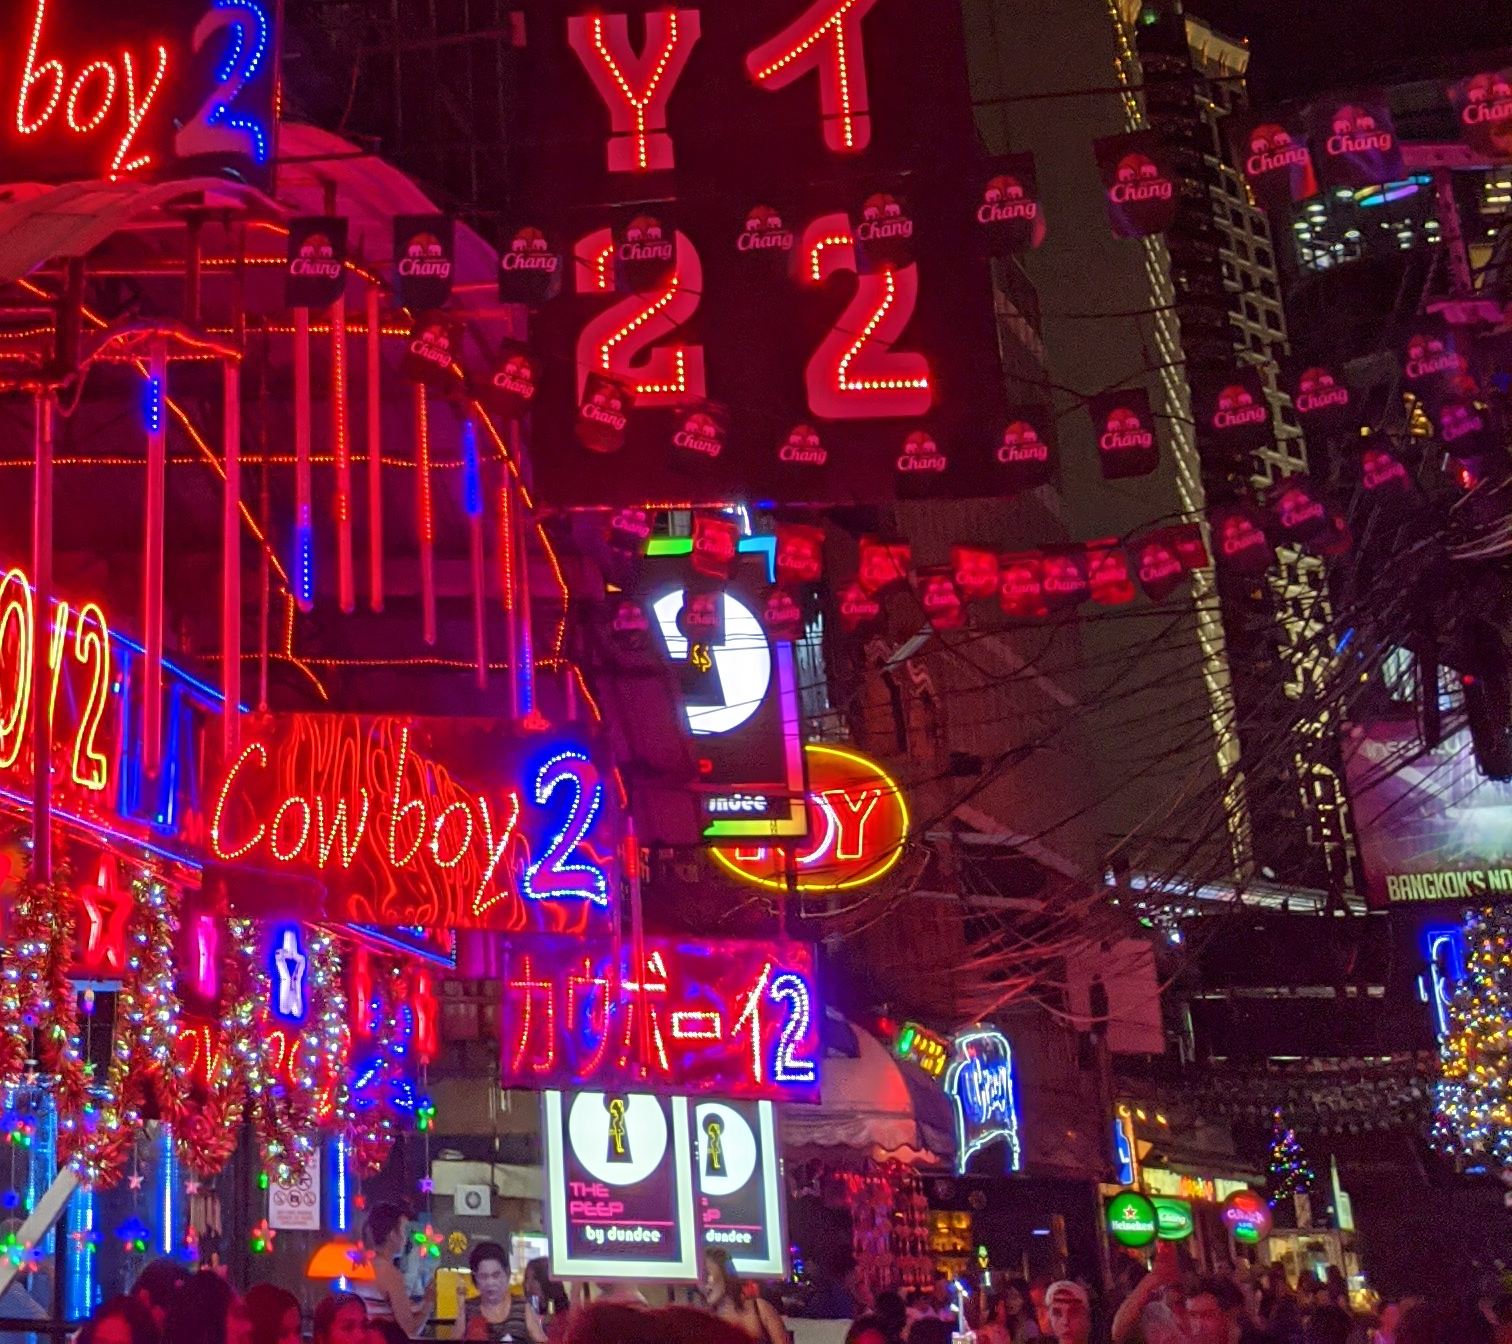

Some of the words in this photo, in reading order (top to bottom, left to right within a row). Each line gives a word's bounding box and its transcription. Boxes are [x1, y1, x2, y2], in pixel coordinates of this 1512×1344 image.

[1463, 101, 1512, 125] Chan
[1326, 132, 1392, 156] Chang
[1246, 147, 1309, 176] Chang
[1109, 178, 1173, 204] Chang
[977, 200, 1036, 224] Chang
[856, 215, 913, 242] Chang
[618, 242, 673, 260] Chang
[737, 231, 794, 251] Chang
[290, 258, 341, 278] Chang
[399, 258, 451, 278] Chang
[501, 253, 558, 273] Chang
[574, 226, 708, 408] 2
[410, 340, 452, 368] Chang
[493, 373, 535, 399] Chang
[1296, 387, 1349, 412] Chang
[581, 402, 627, 431] Chang
[1213, 405, 1267, 429] Chang
[672, 430, 722, 458] Chang
[1100, 429, 1153, 451] Chang
[779, 444, 828, 466] Chang
[897, 454, 948, 473] Chang
[997, 442, 1048, 463] Chang
[71, 603, 110, 791] 2
[210, 727, 521, 917] Cowboy
[523, 750, 608, 907] 2
[1386, 870, 1486, 902] BANGKOK'S
[569, 1181, 610, 1198] THE
[569, 1200, 625, 1217] PEEP
[584, 1224, 605, 1245] by
[606, 1226, 662, 1243] dundee
[705, 1229, 753, 1244] dundee
[1111, 1219, 1155, 1232] Heineken
